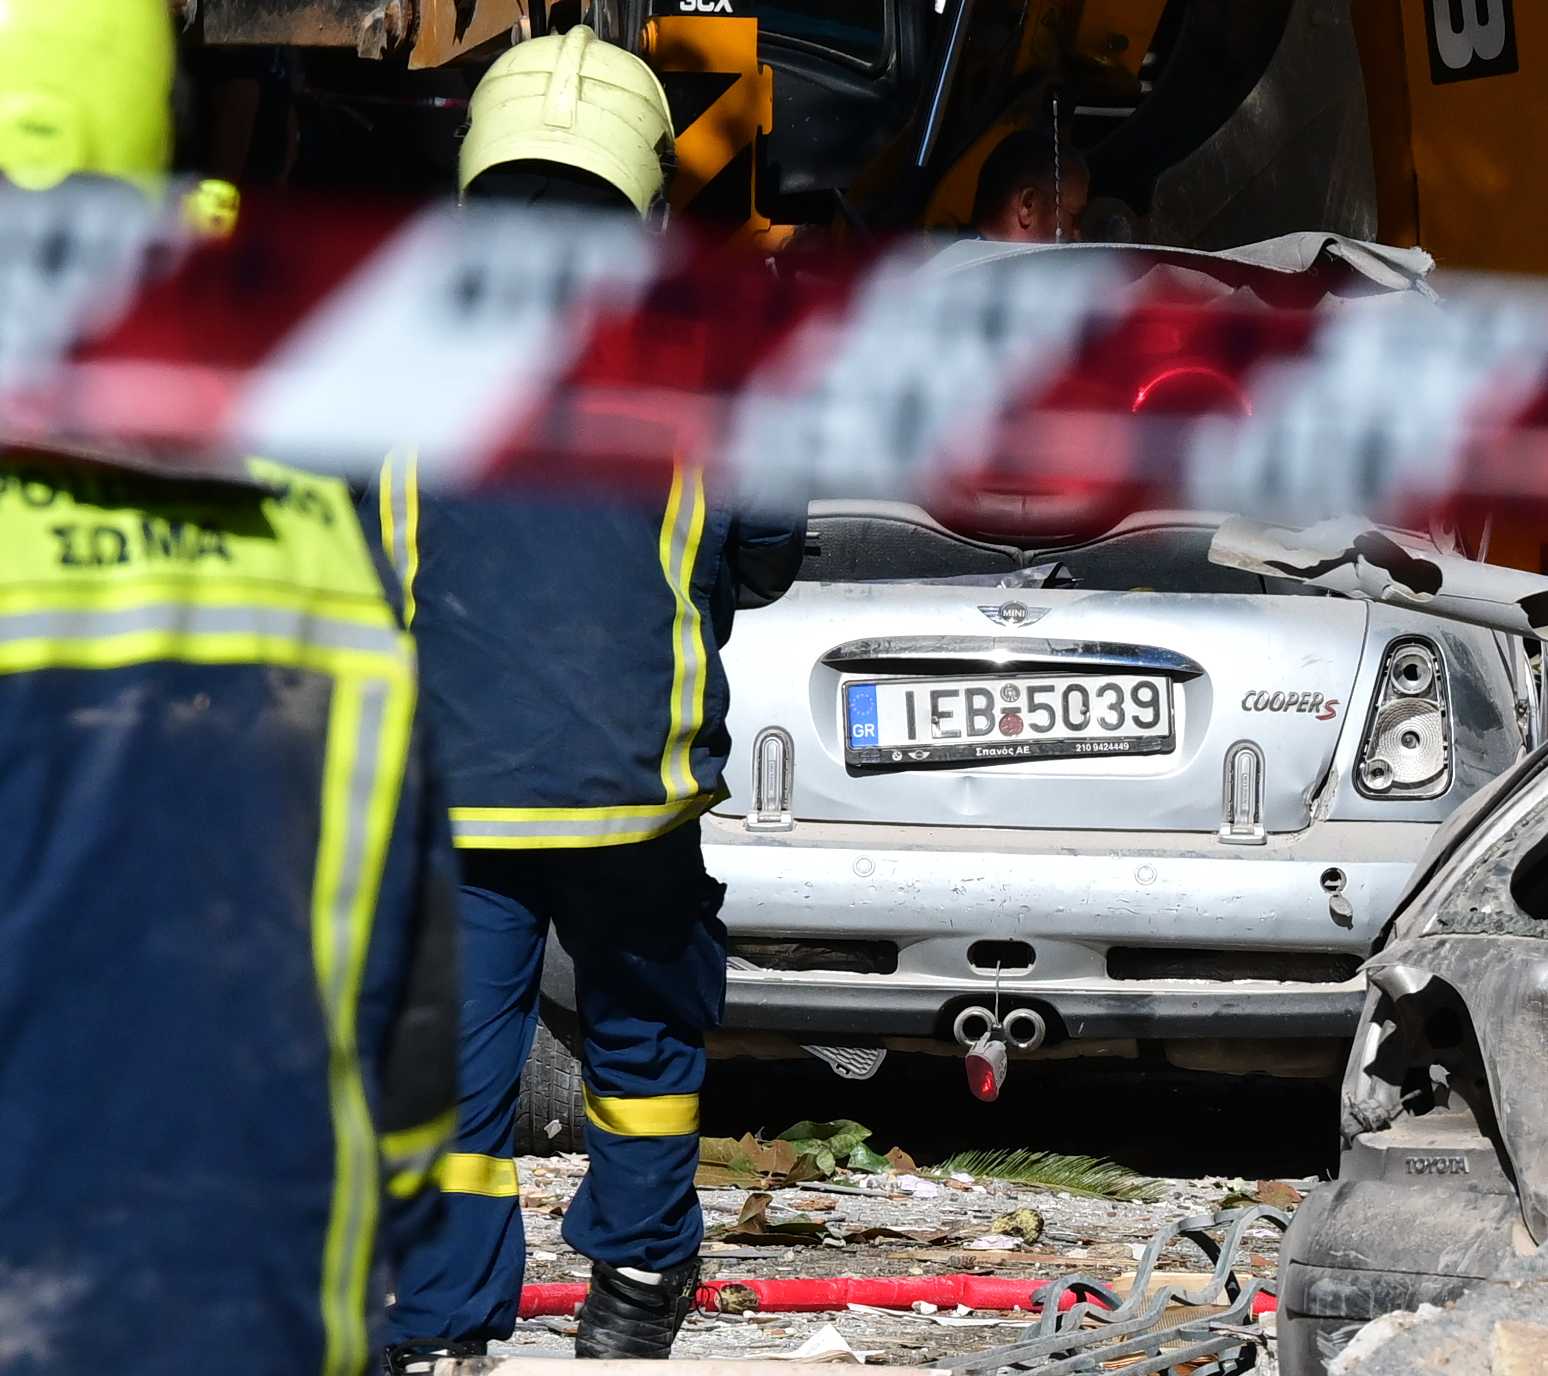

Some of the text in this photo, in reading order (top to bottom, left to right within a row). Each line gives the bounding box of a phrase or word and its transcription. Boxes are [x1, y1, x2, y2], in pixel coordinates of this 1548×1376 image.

[52, 520, 234, 569] ΣΩΜΑ
[1002, 609, 1025, 617] MINI
[1241, 690, 1325, 713] COOPER
[853, 724, 876, 738] GR
[976, 745, 1014, 758] Σπανός
[1076, 743, 1091, 753] 210
[1092, 742, 1130, 752] 9424449
[1406, 1156, 1470, 1174] TOYOTA
